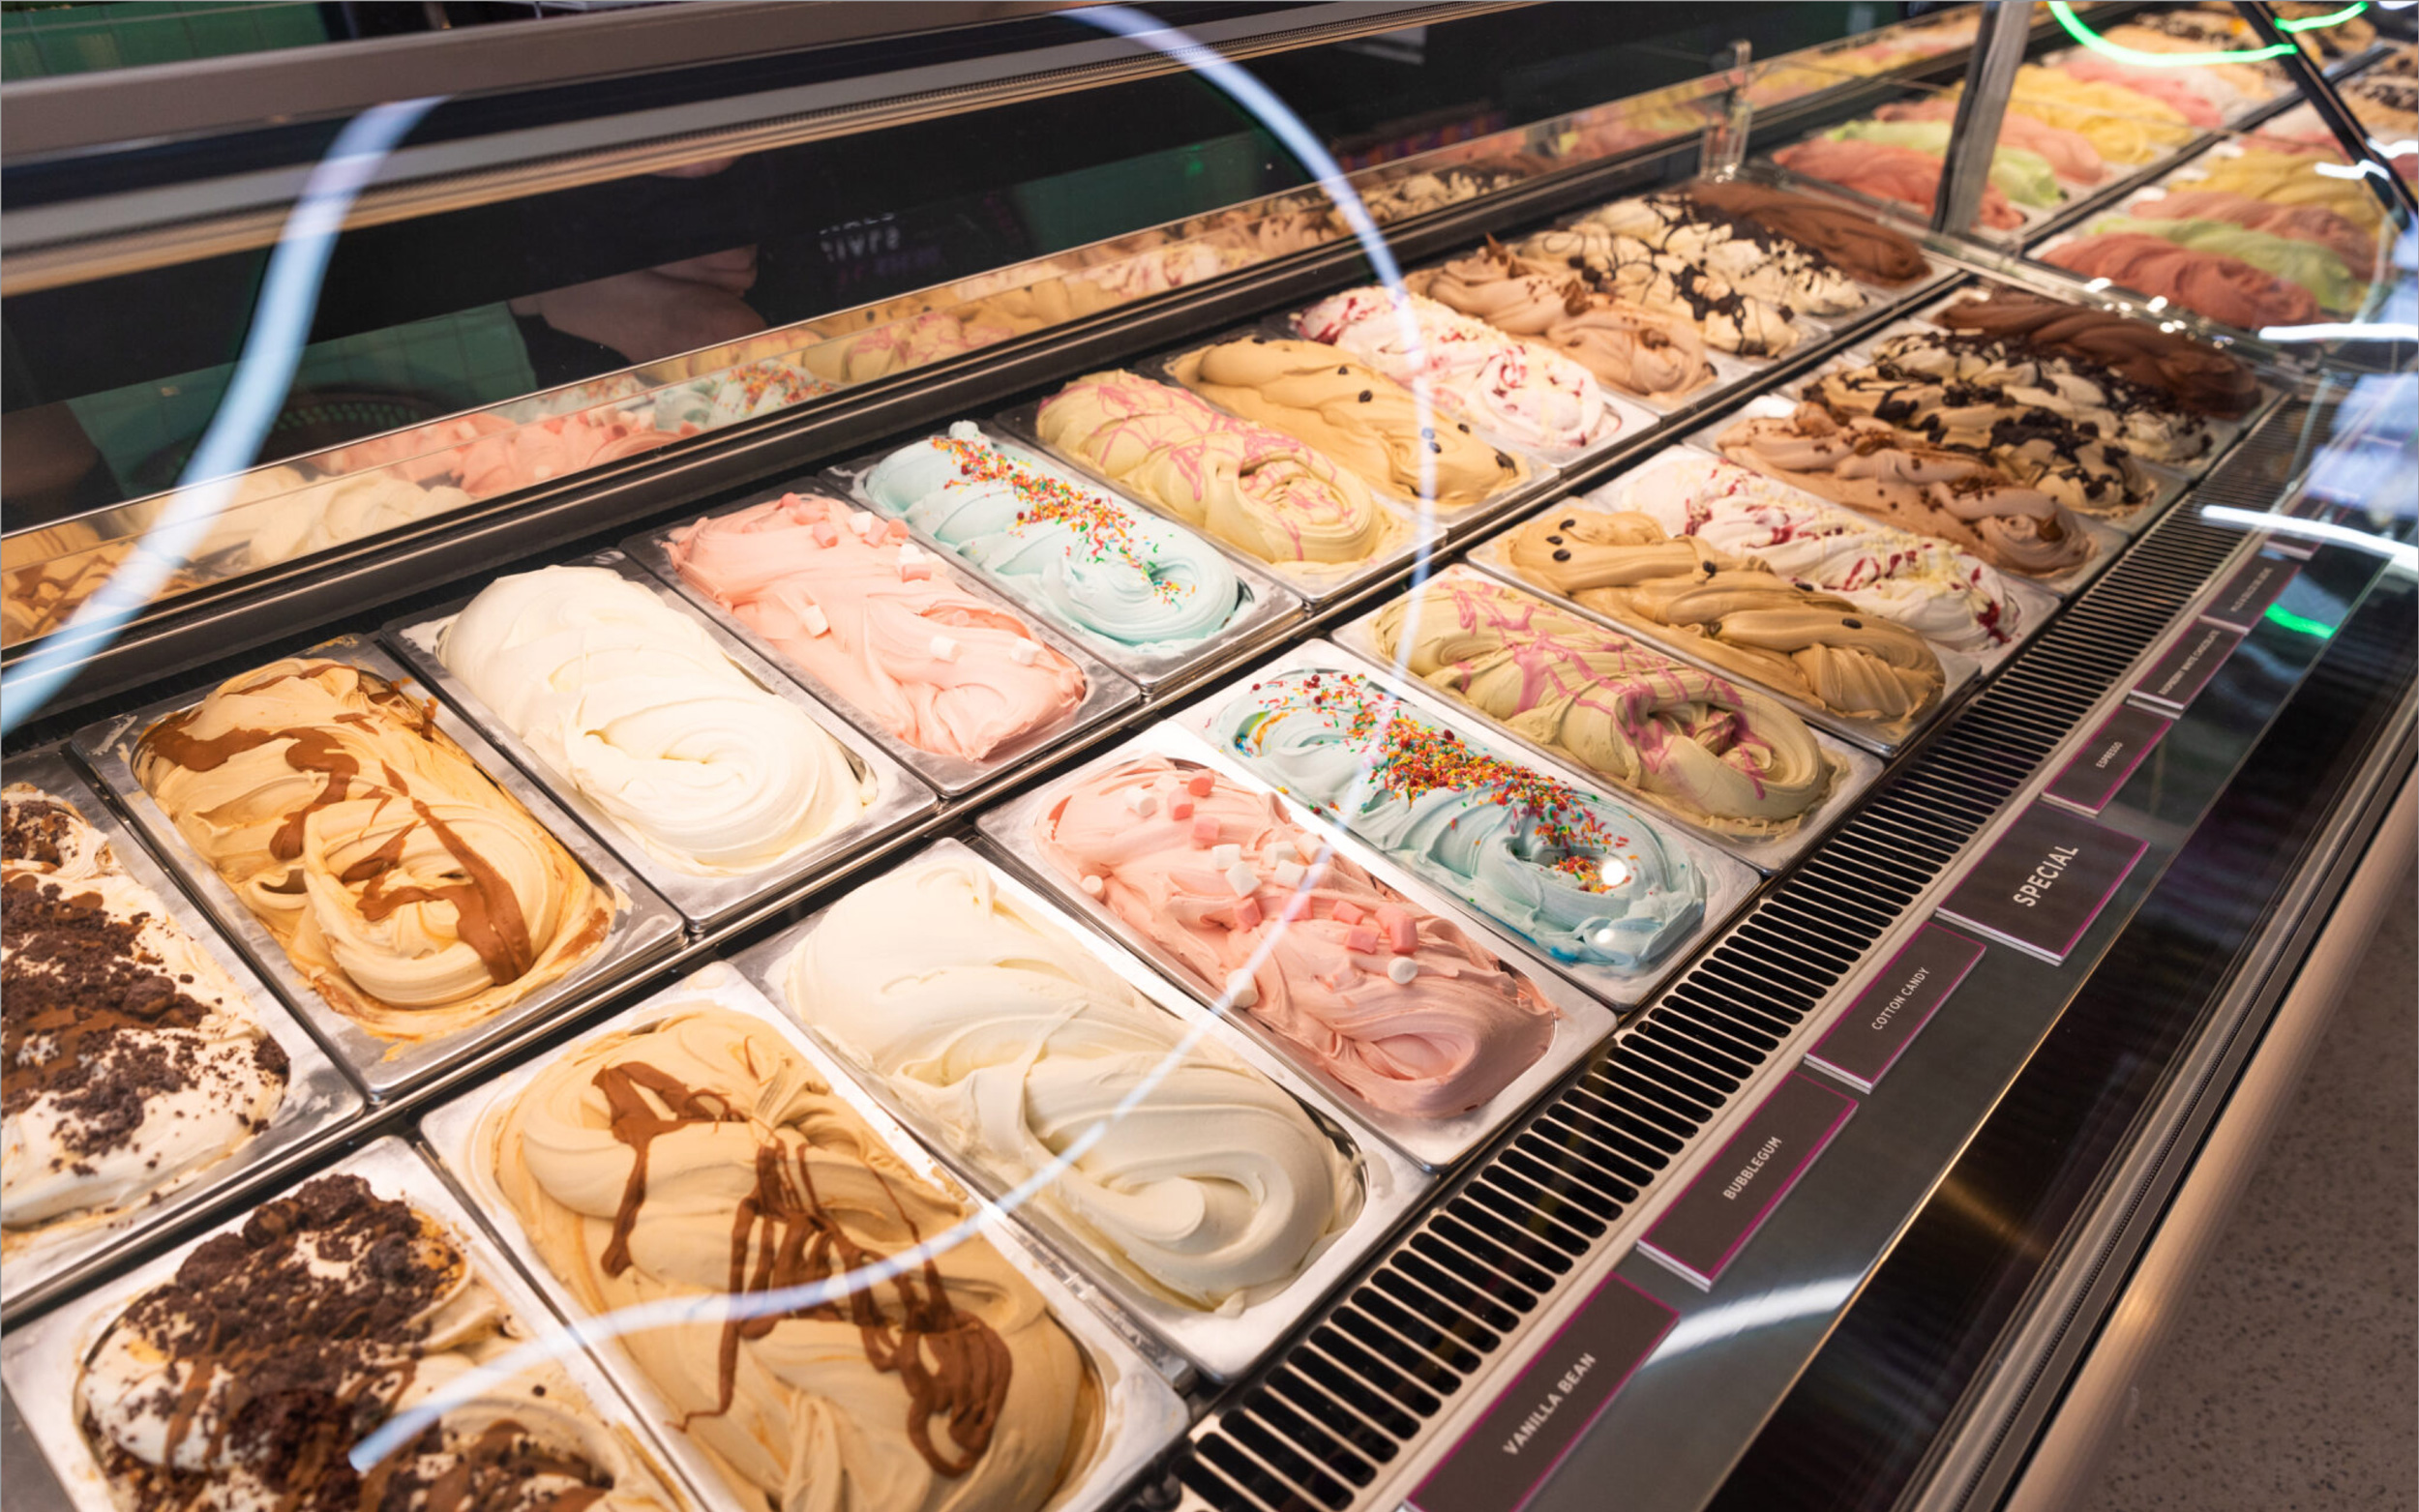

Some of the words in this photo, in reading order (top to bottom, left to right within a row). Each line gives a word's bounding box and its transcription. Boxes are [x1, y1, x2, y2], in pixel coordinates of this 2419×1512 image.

[2096, 741, 2123, 768] ESPRESSO
[2013, 845, 2079, 907] SPECIAL
[1871, 995, 1906, 1030] COTTON
[1900, 966, 1930, 996] CANDY
[1723, 1136, 1782, 1201] BUBBLEGUM
[1503, 1393, 1563, 1455] VANILLA
[1557, 1352, 1597, 1394] BEAN
